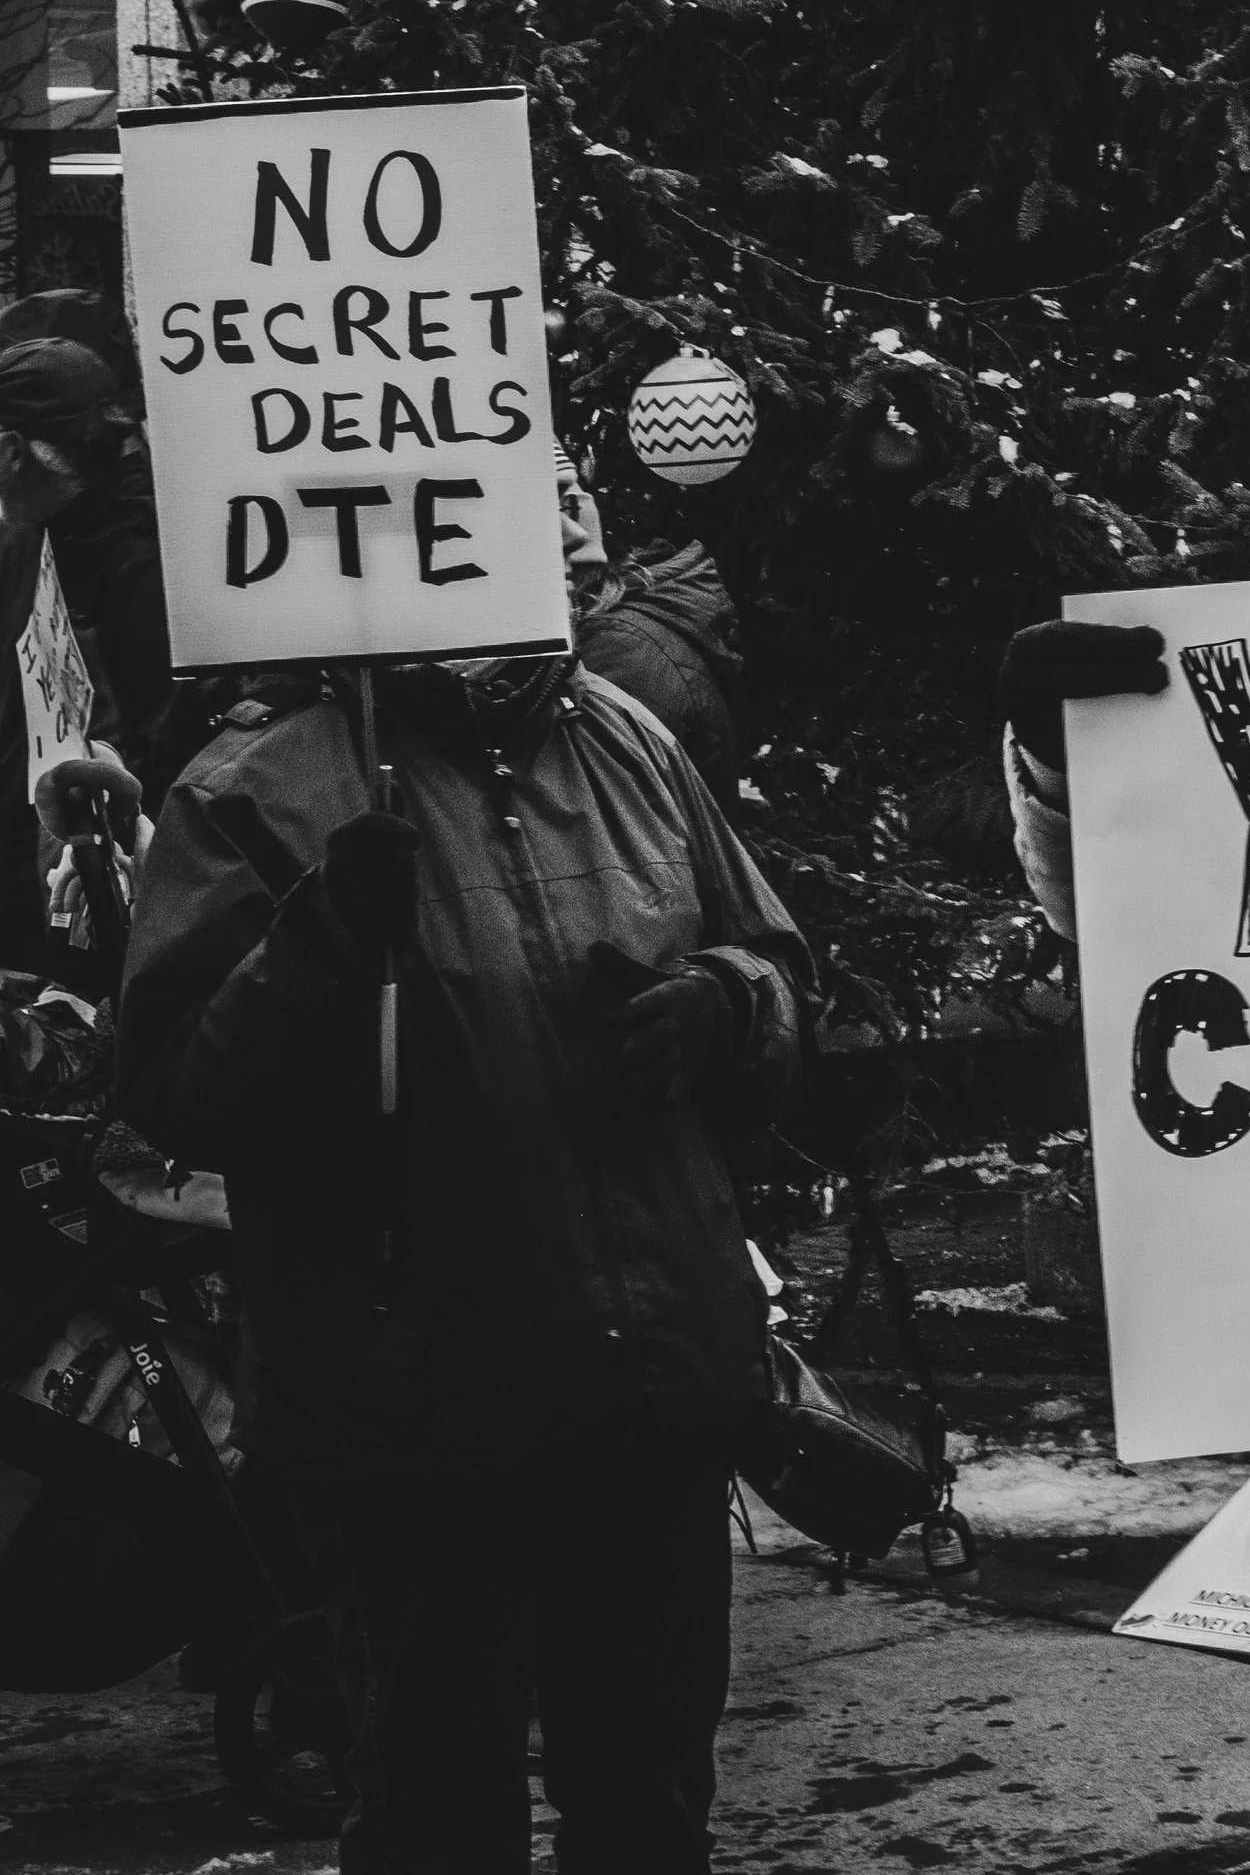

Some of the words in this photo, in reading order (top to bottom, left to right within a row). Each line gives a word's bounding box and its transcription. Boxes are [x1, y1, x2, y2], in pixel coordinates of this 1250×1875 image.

[250, 148, 442, 266] NO
[160, 285, 524, 374] SECRET
[251, 376, 532, 455] DEALS
[225, 477, 489, 590] DTE
[130, 1342, 164, 1386] Joie
[1168, 1612, 1232, 1631] MONEY
